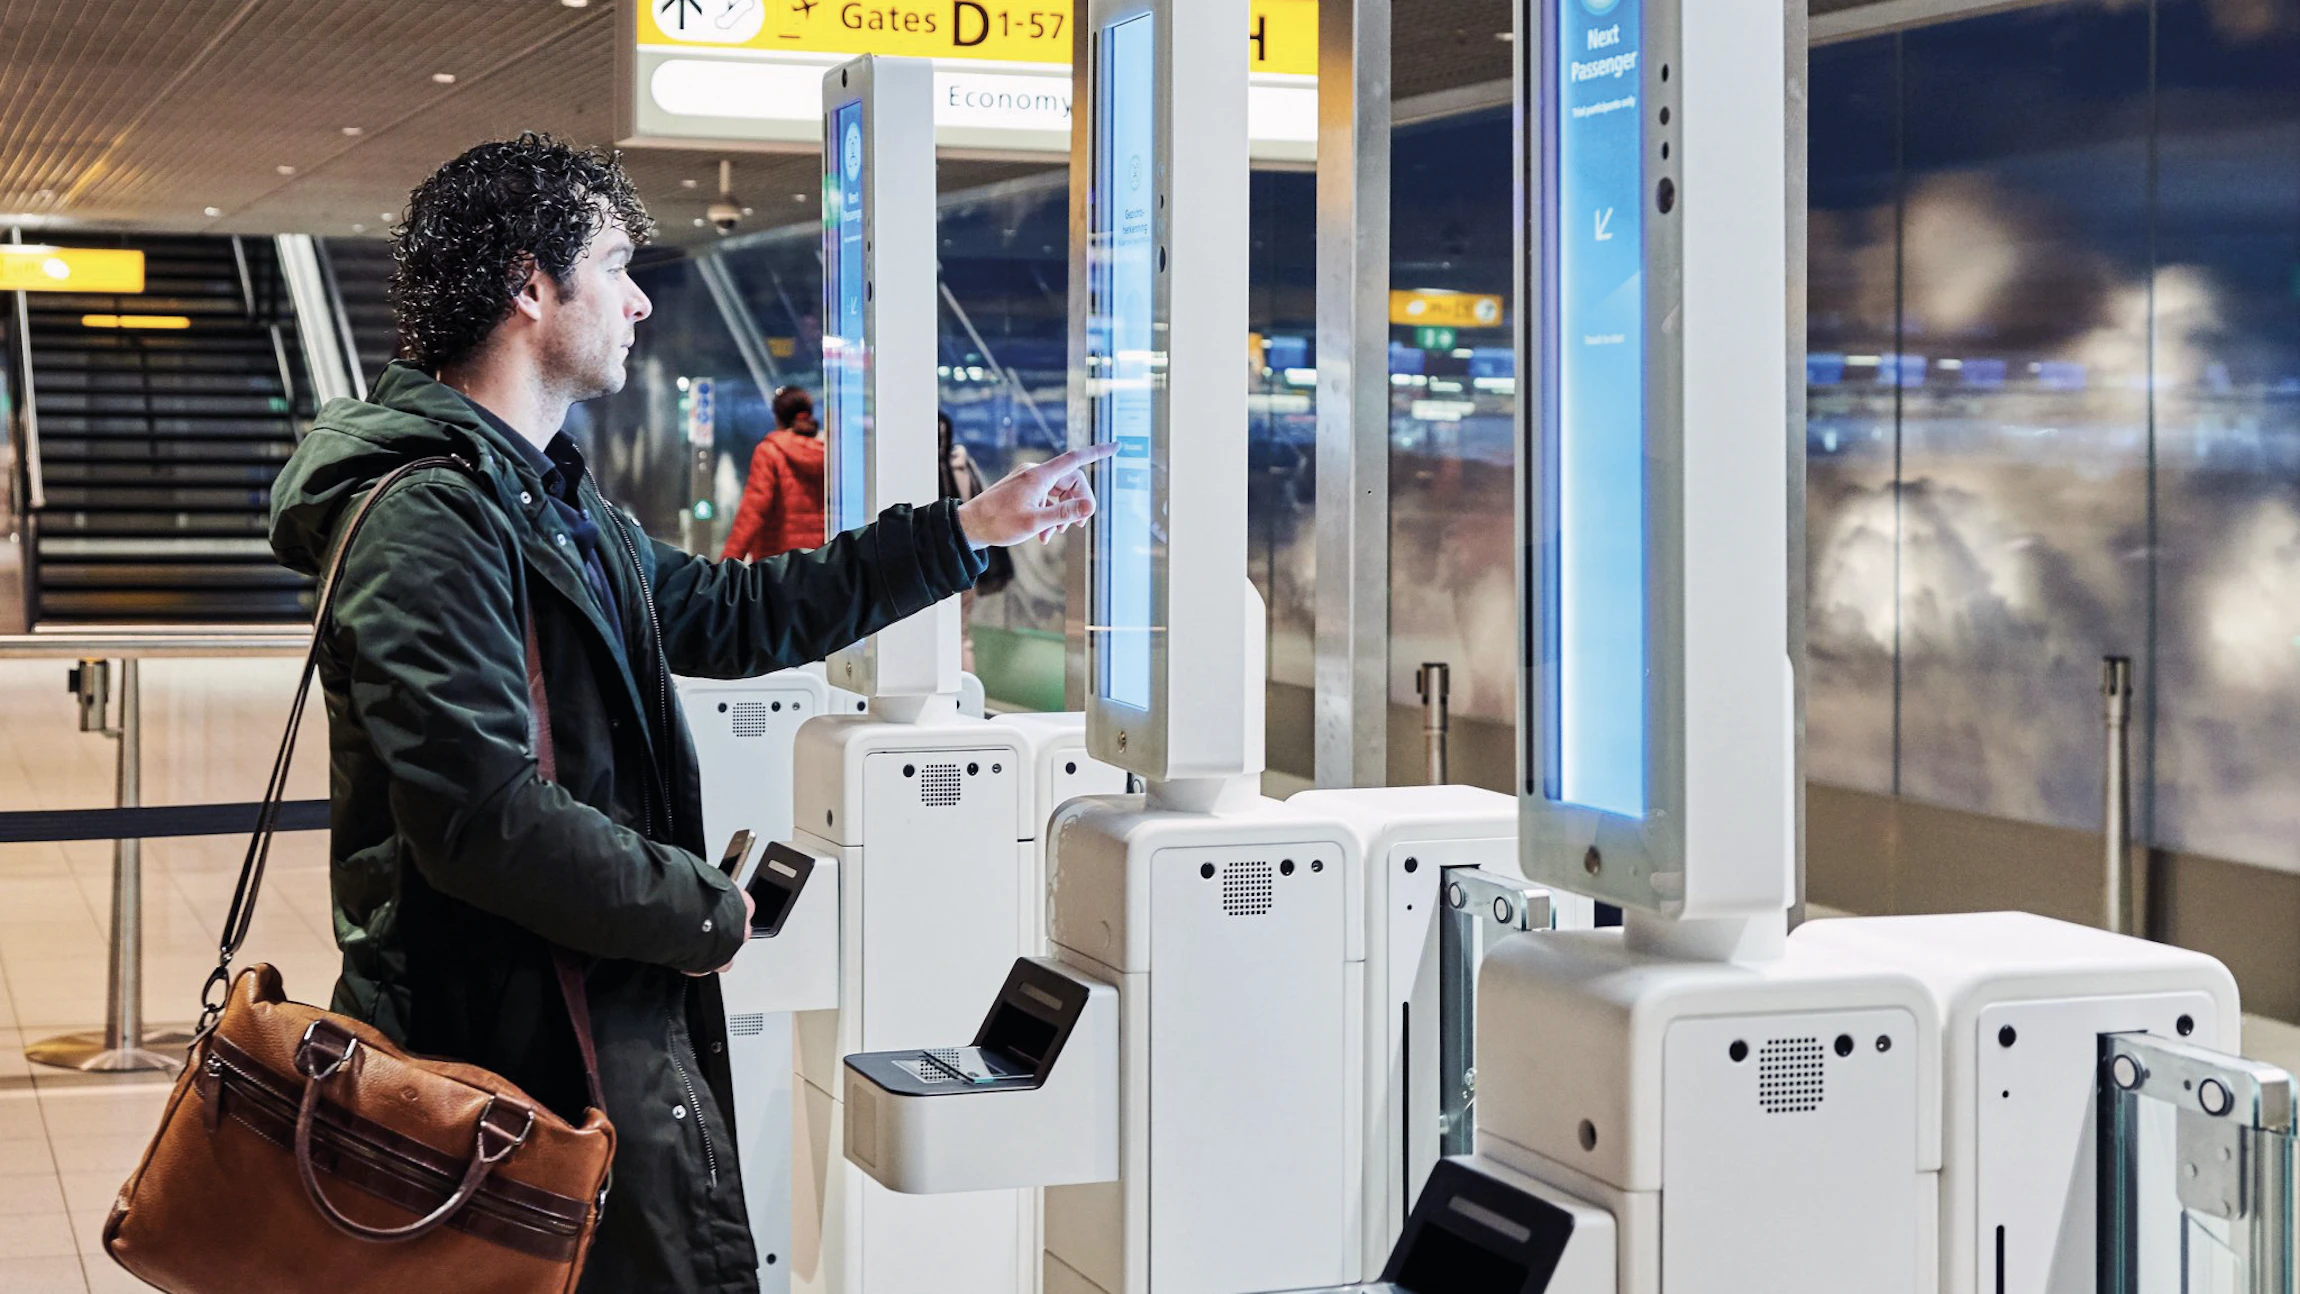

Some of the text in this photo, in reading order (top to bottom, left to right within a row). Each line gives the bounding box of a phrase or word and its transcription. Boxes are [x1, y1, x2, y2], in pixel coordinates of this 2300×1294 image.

[841, 3, 937, 33] Gates
[953, 1, 989, 47] D
[998, 12, 1064, 39] 1-57
[1587, 24, 1620, 50] Next
[1571, 51, 1638, 82] Passenger
[949, 85, 1071, 117] Economy
